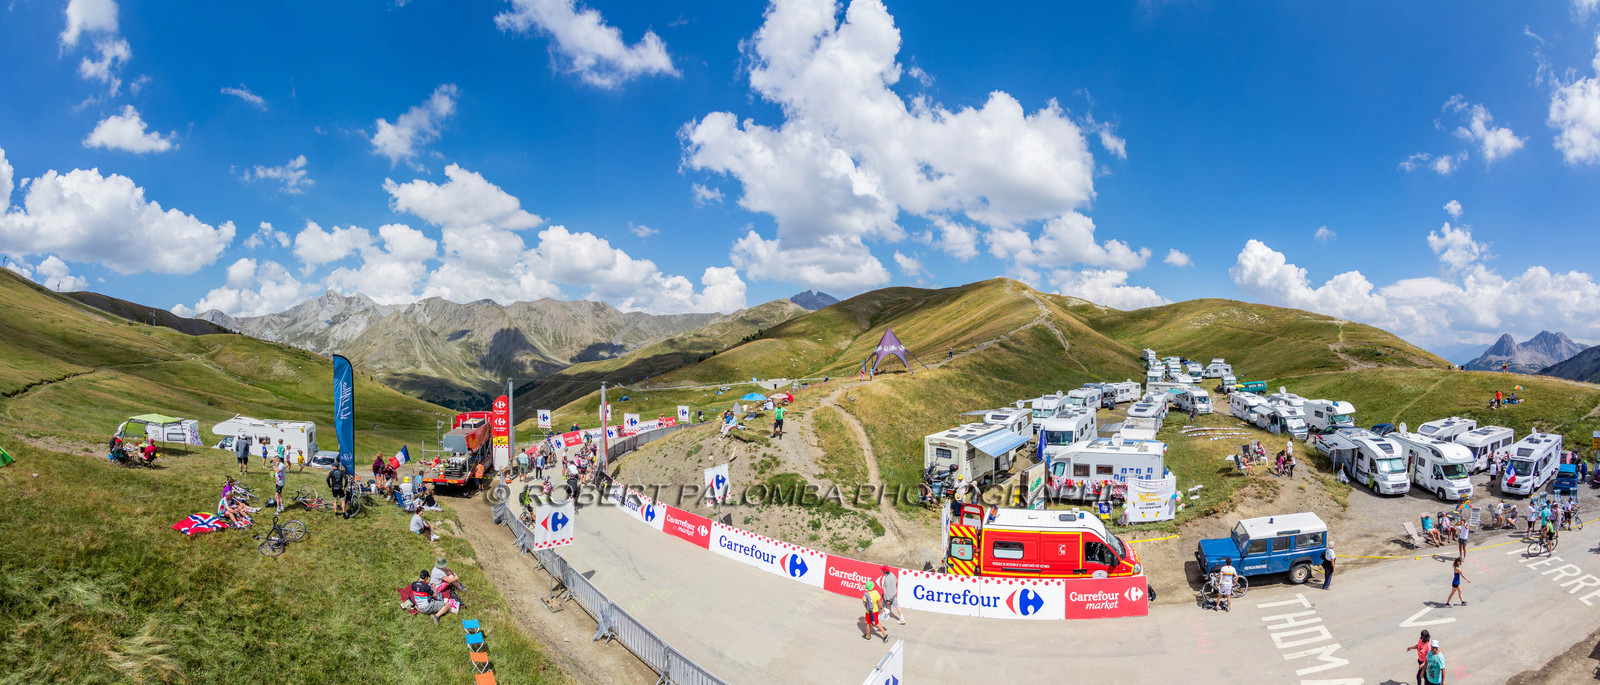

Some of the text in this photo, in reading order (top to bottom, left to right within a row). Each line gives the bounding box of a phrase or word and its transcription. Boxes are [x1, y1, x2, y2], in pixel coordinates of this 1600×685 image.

[718, 534, 777, 565] Carrefour
[828, 566, 872, 583] Carrefour
[840, 580, 868, 592] marke
[913, 584, 1001, 608] Carrefour
[1069, 591, 1120, 602] Carrefour
[1085, 599, 1120, 610] market
